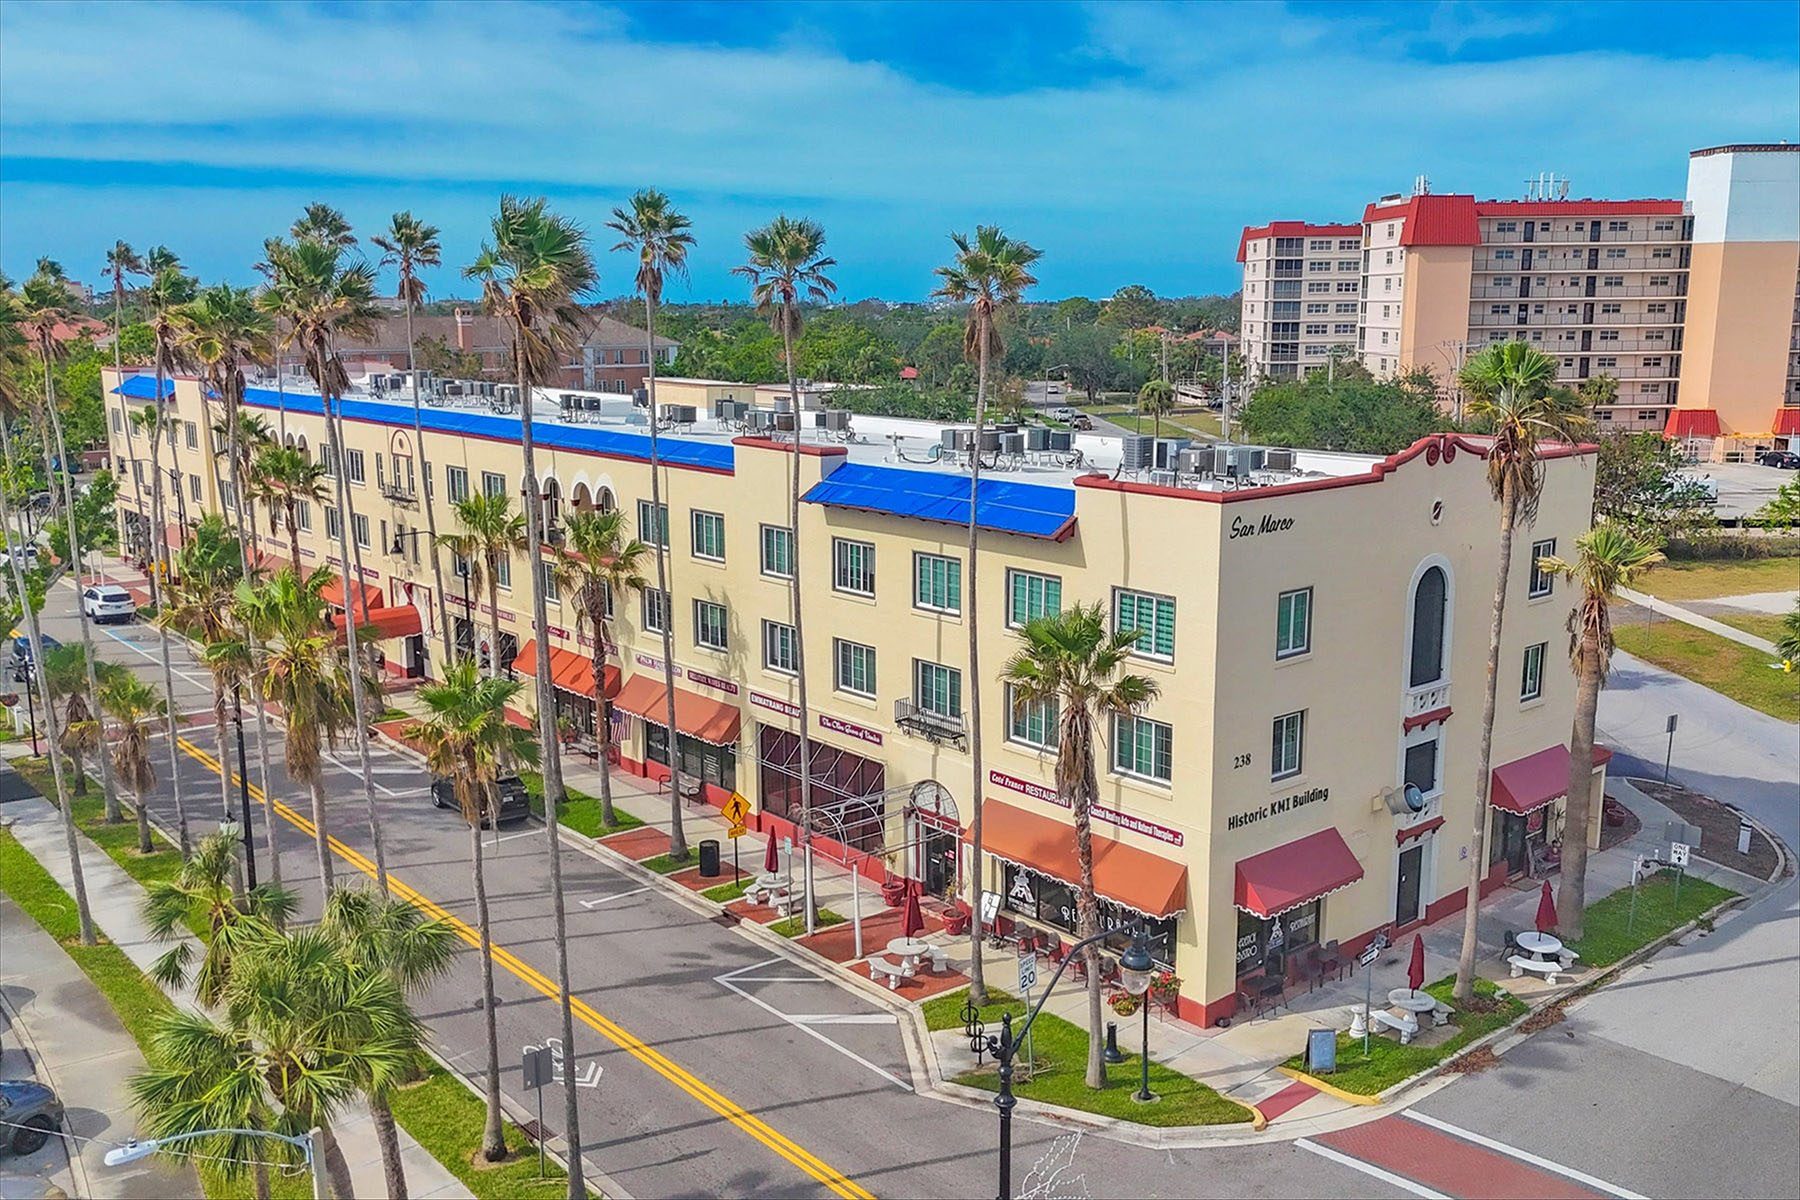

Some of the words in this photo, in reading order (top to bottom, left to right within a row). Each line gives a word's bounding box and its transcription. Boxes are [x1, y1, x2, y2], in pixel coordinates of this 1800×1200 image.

[1229, 515, 1255, 540] San
[1257, 513, 1296, 536] Marco
[784, 706, 801, 718] BEAU
[1233, 752, 1252, 770] 238
[1227, 806, 1269, 831] Historic
[1269, 797, 1291, 817] KMI
[1292, 787, 1329, 809] Building
[1021, 970, 1035, 989] 20
